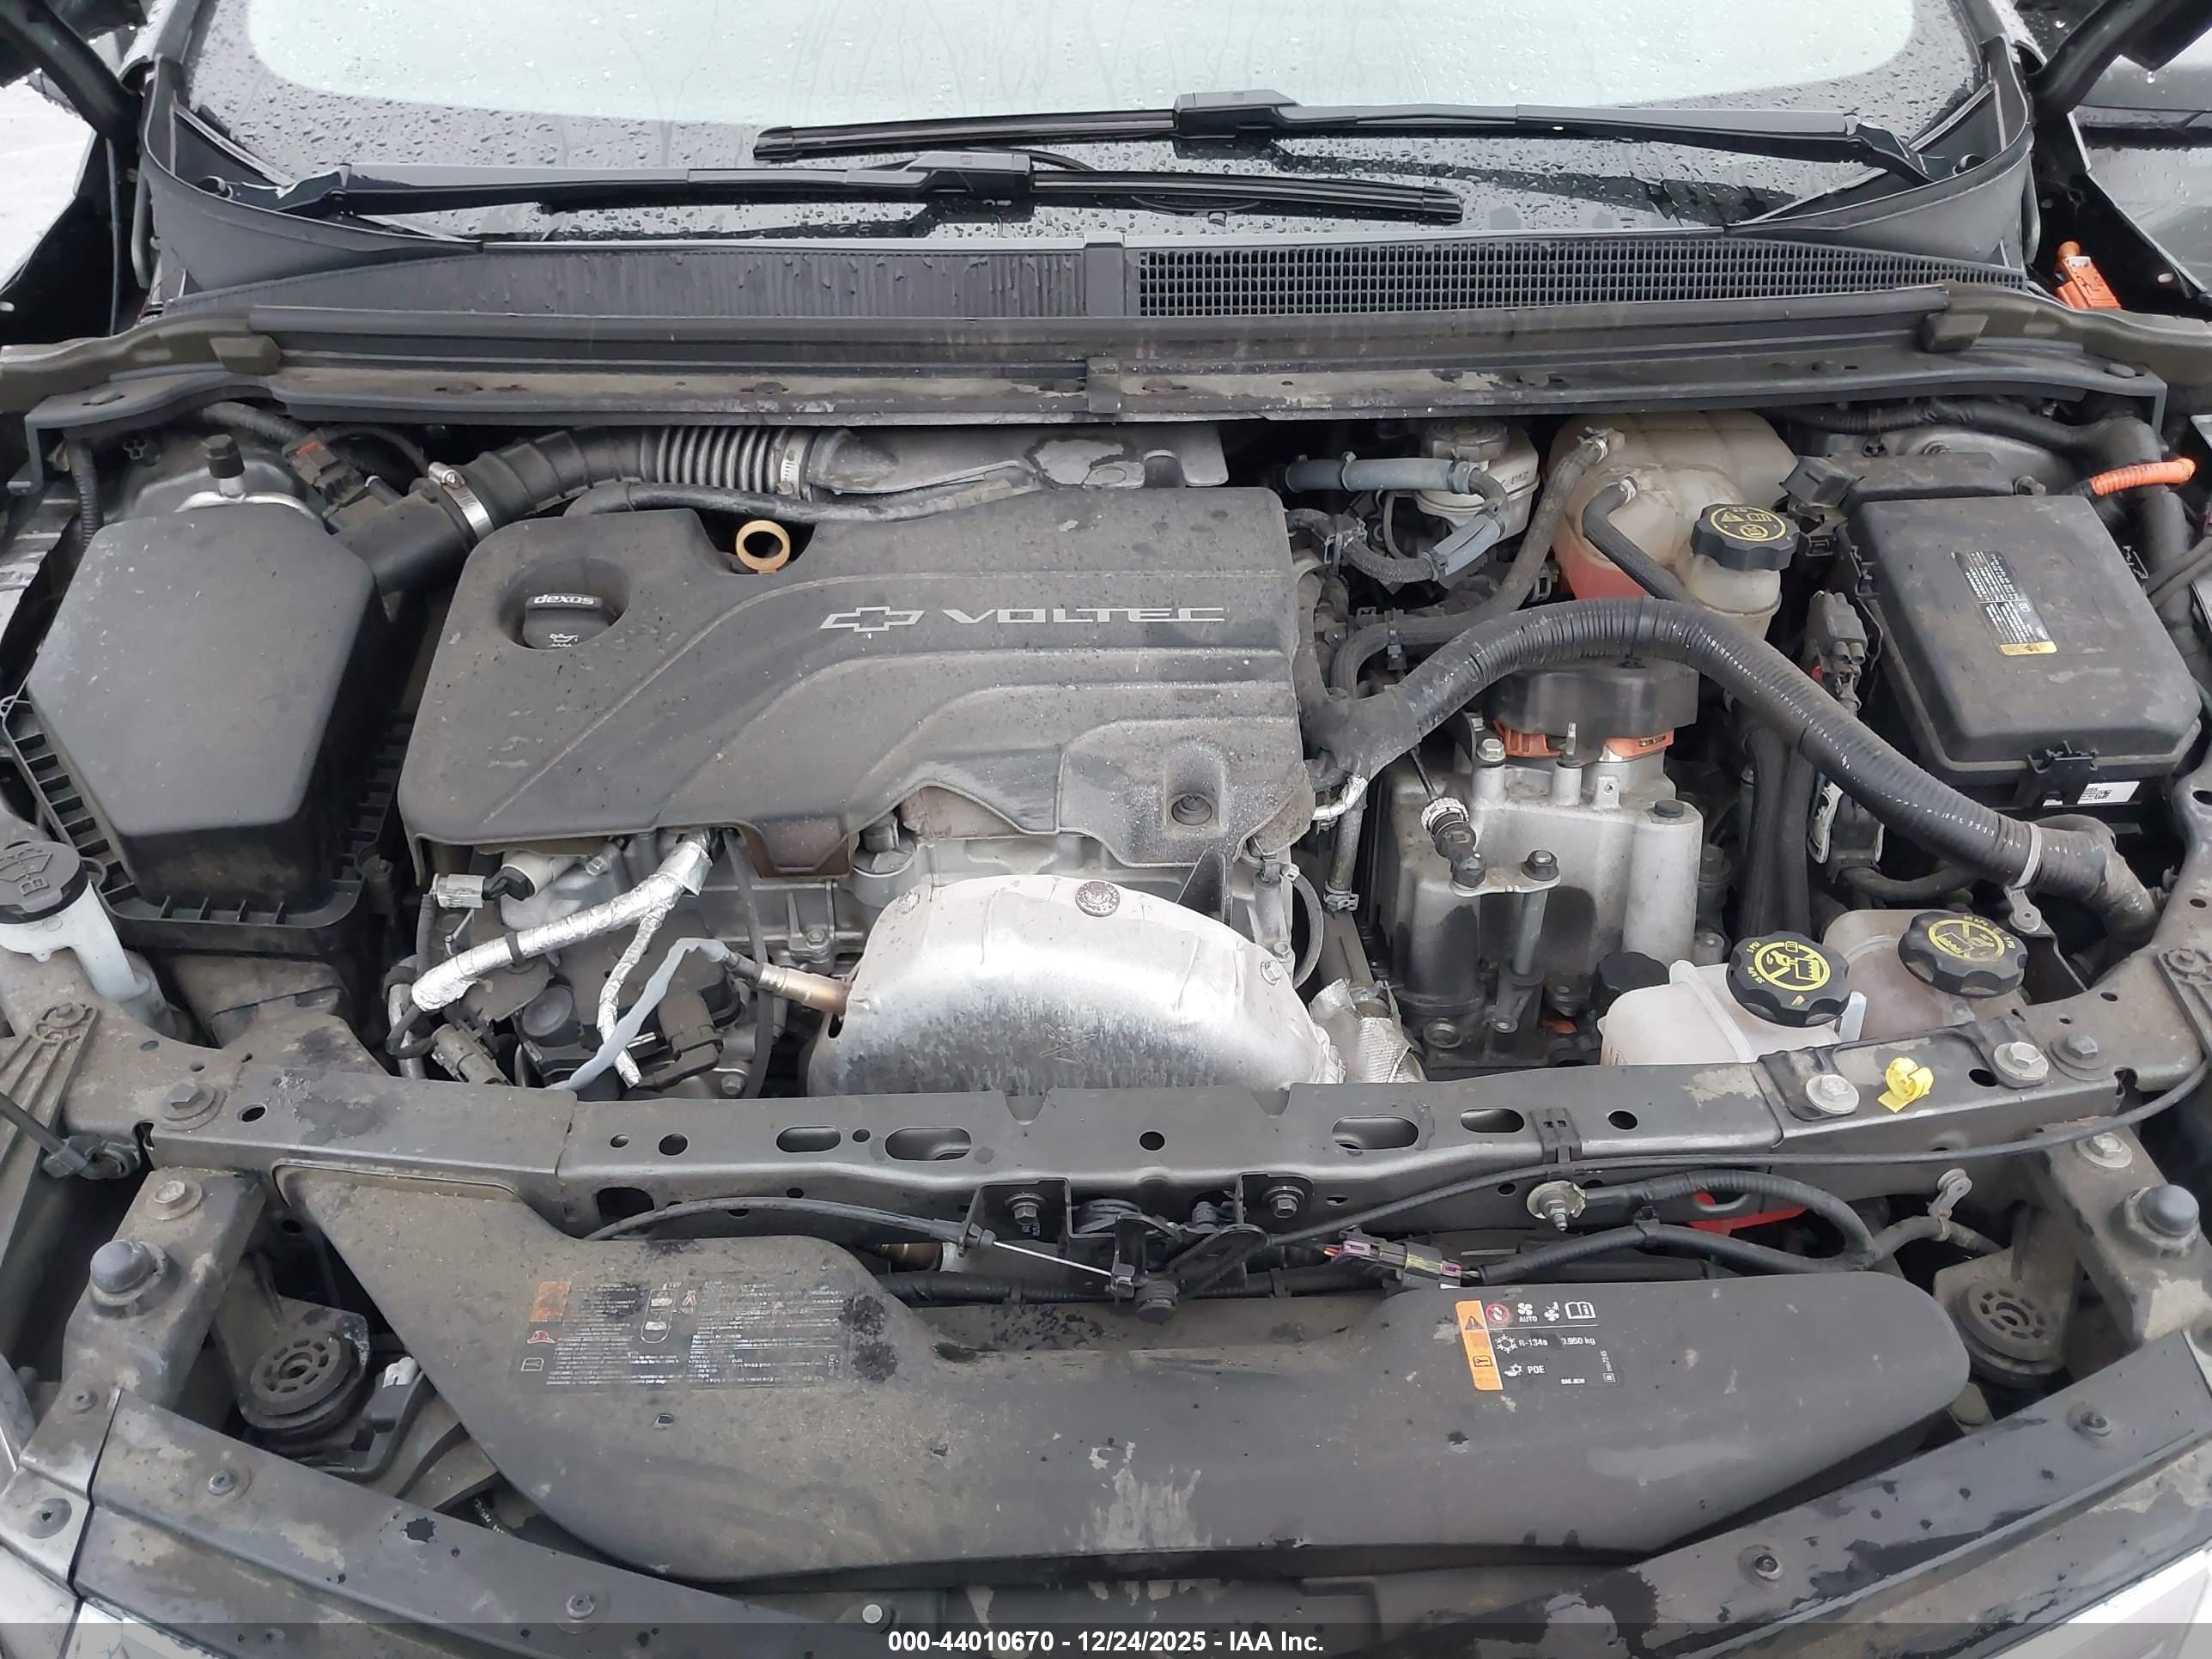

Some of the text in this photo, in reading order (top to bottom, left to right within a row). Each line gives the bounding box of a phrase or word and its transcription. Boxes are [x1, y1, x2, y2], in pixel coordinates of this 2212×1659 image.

[533, 594, 595, 605] dexos
[942, 608, 1226, 623] VOLTEC
[1518, 1338, 1548, 1347] R-134a
[1584, 1336, 1596, 1346] kg
[1527, 1364, 1546, 1375] POE
